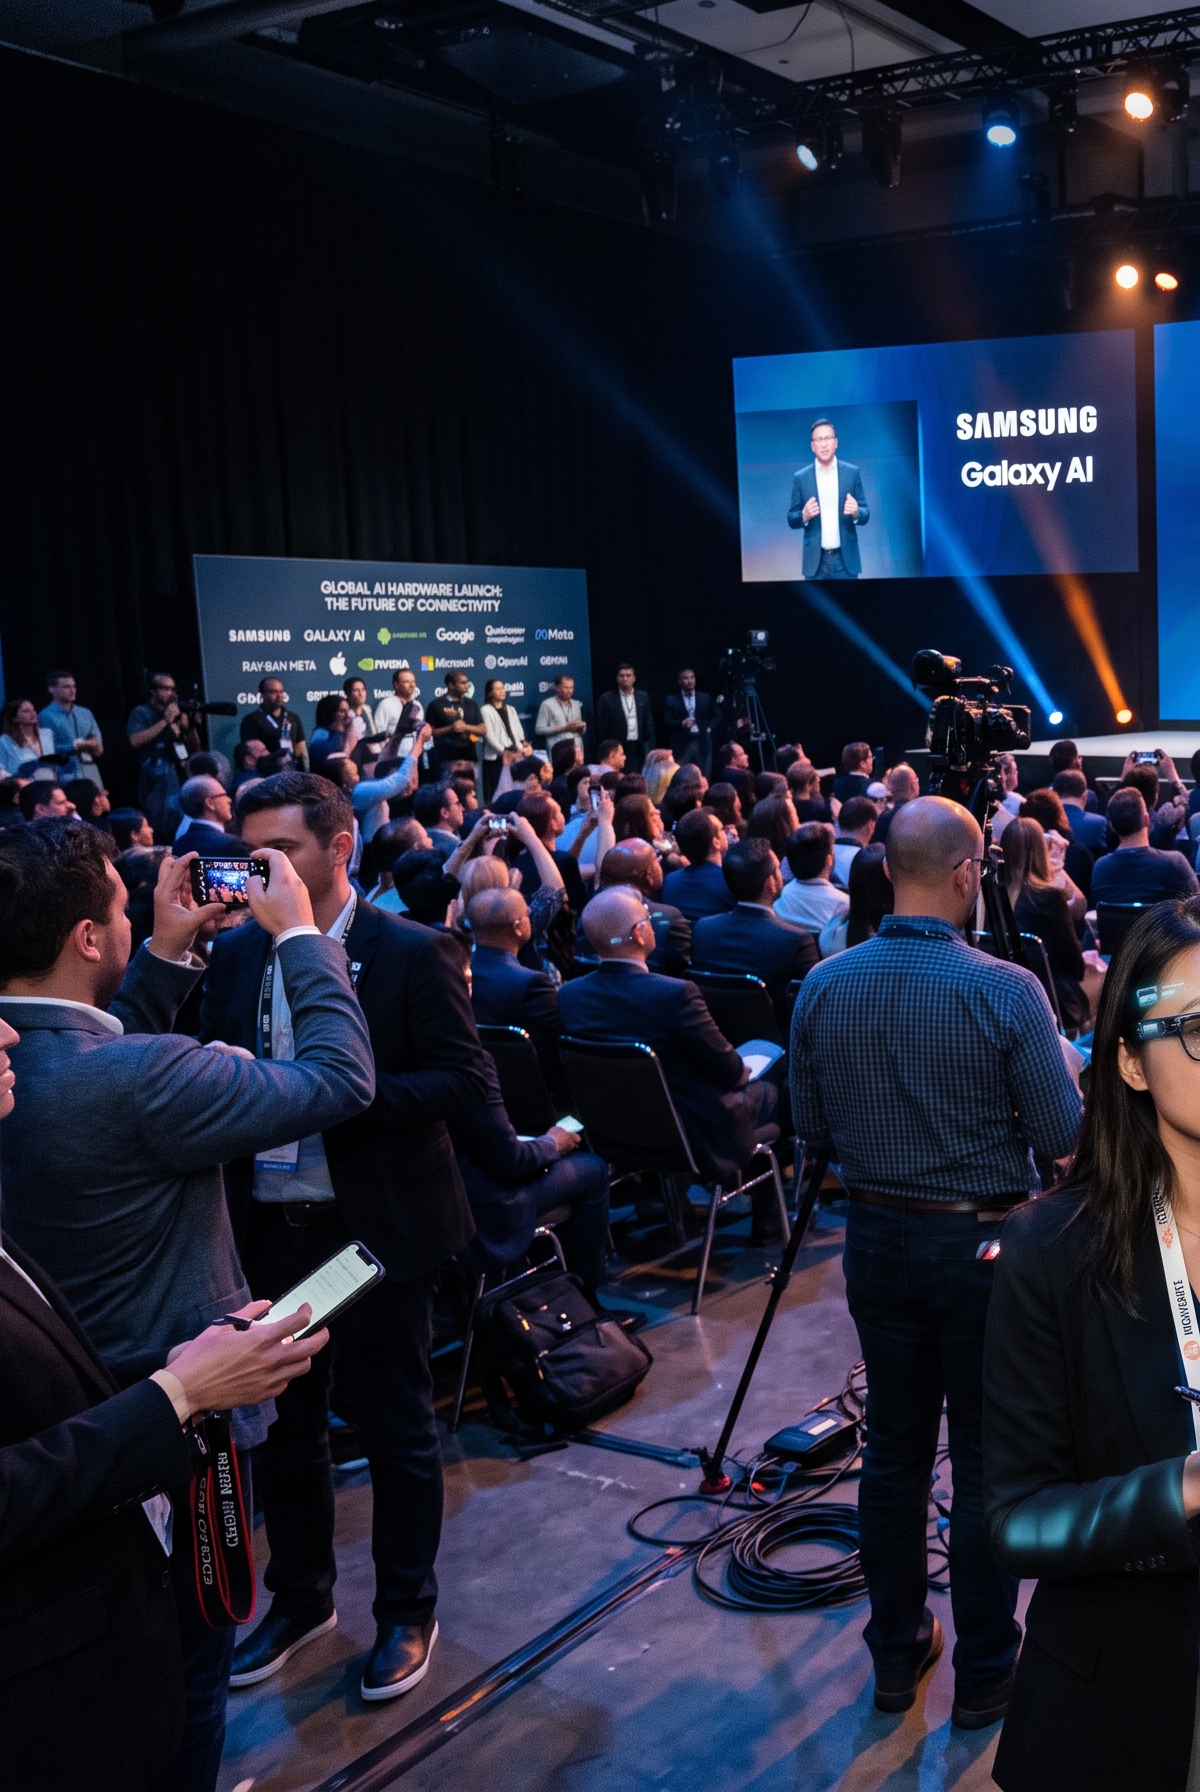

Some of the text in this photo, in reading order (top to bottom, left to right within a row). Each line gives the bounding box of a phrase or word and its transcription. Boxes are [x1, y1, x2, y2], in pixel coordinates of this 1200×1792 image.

[956, 405, 1097, 440] SAMSUNG
[960, 456, 1094, 491] Galaxy AI
[320, 580, 371, 595] GLOBAL
[373, 582, 386, 595] AI
[388, 582, 453, 597] HARDWARE
[325, 597, 500, 612] THE FUTURE OF CONNECTIVITY
[304, 629, 366, 642] GALAXY AI
[436, 627, 475, 645] Google
[288, 660, 317, 672] META
